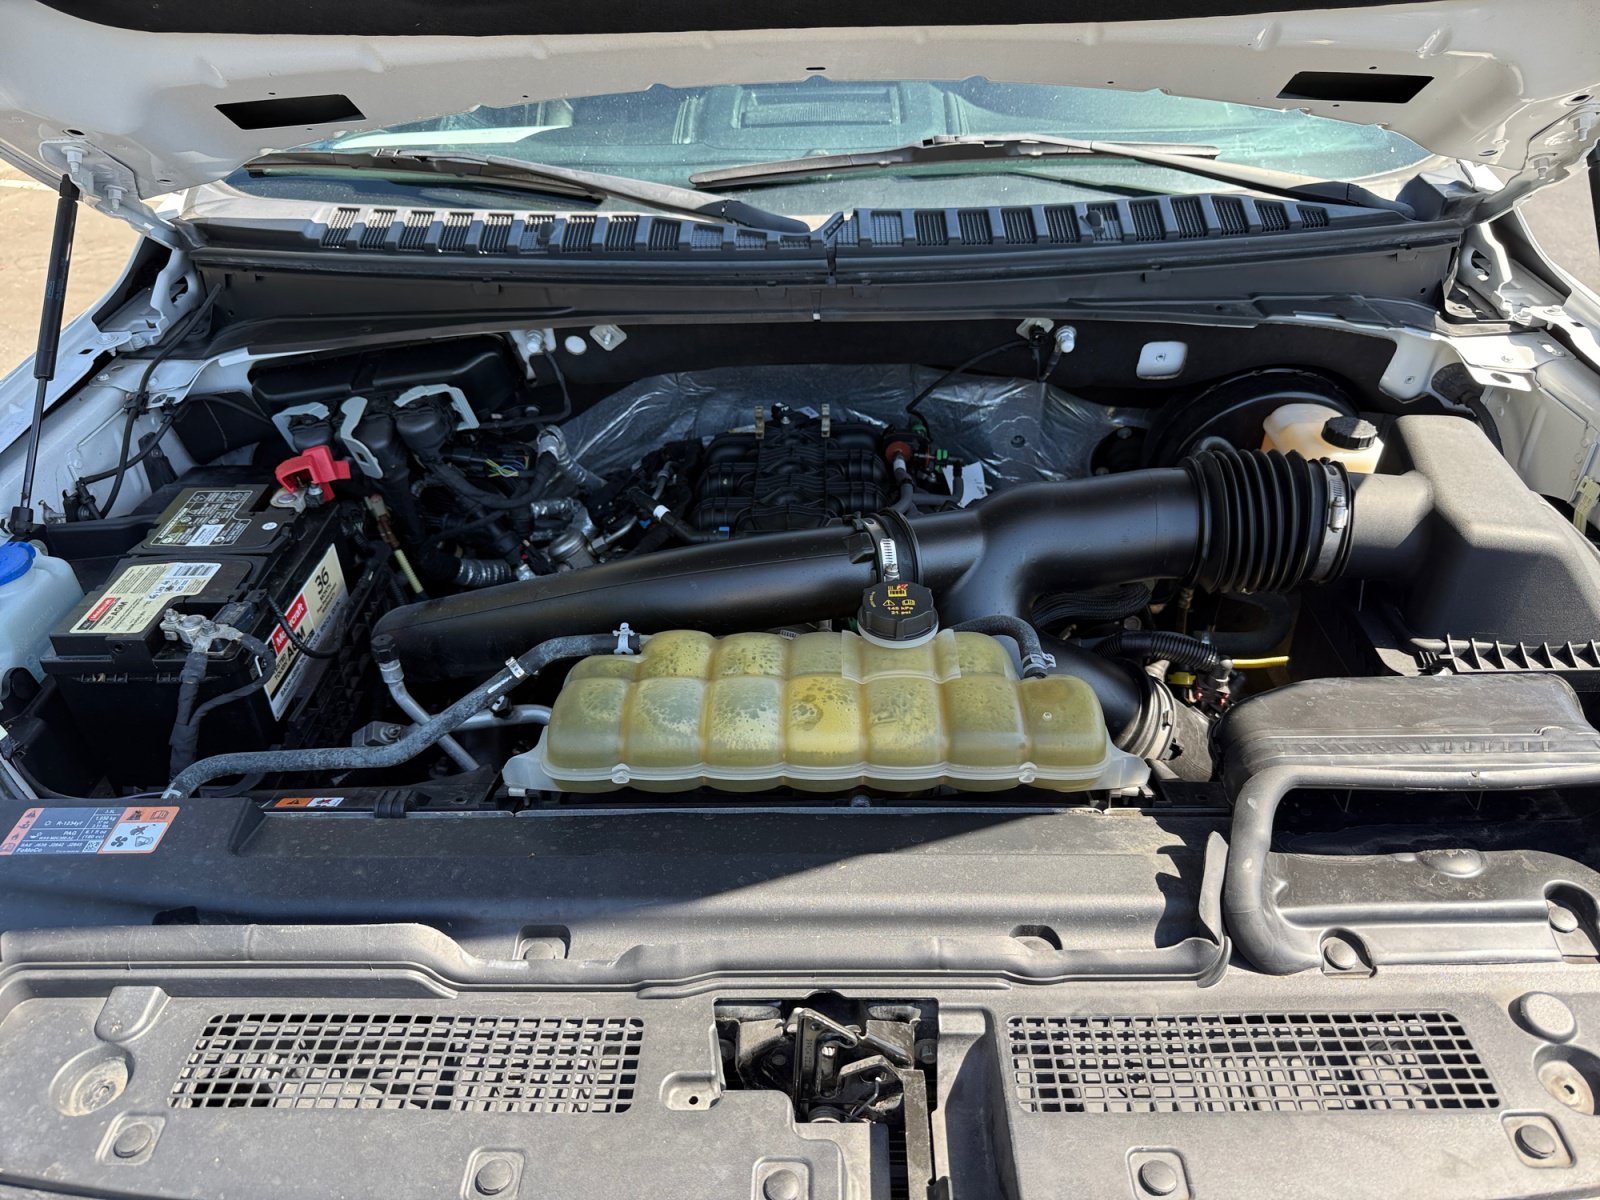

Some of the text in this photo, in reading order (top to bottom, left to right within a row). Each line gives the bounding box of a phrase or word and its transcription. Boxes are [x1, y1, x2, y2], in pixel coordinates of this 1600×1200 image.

[314, 565, 330, 595] 36
[111, 601, 129, 616] AGM
[275, 600, 306, 648] Morcraft
